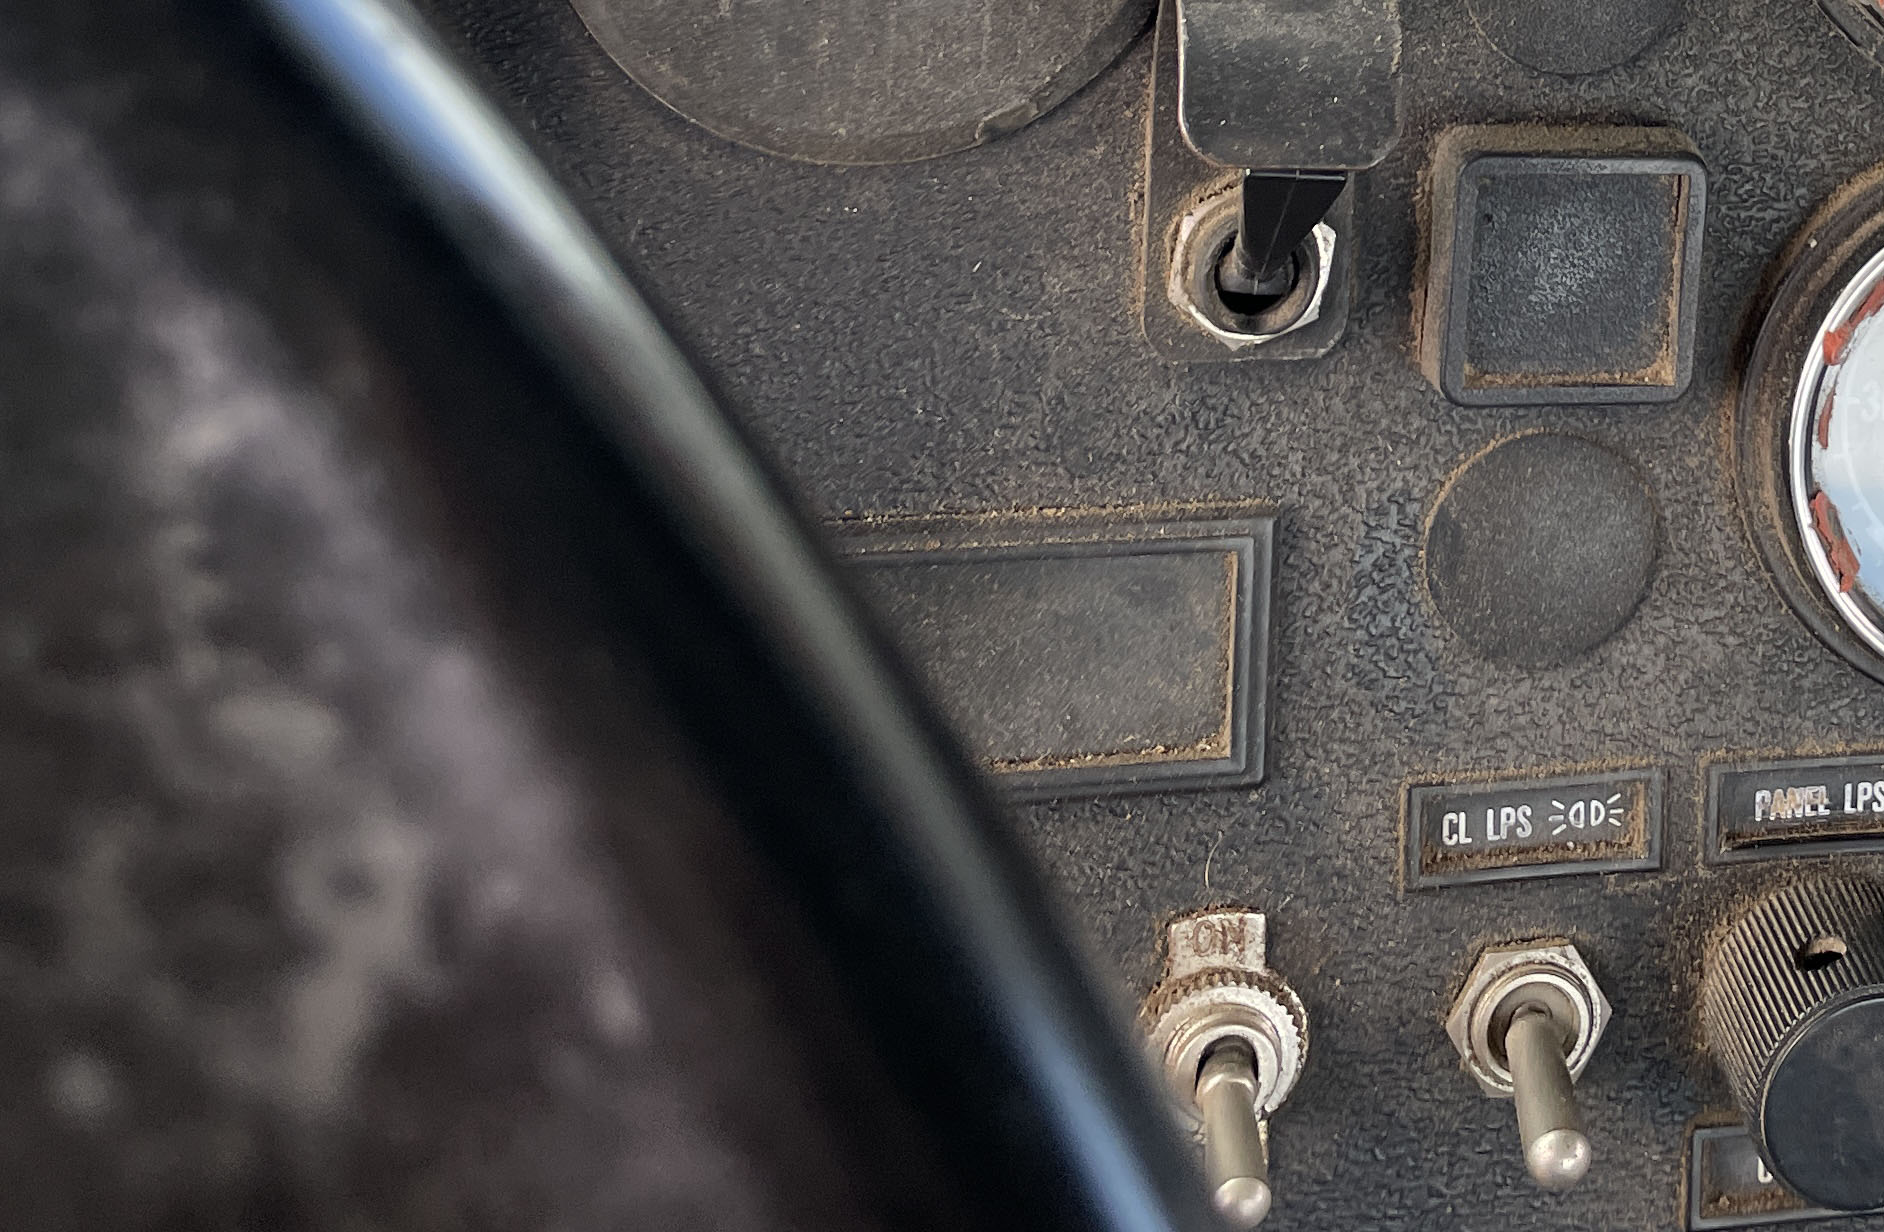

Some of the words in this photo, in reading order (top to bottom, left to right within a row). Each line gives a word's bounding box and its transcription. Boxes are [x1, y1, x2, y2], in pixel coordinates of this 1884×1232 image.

[1754, 785, 1831, 822] PANEL
[1442, 812, 1473, 846] CL
[1486, 805, 1533, 842] LPS
